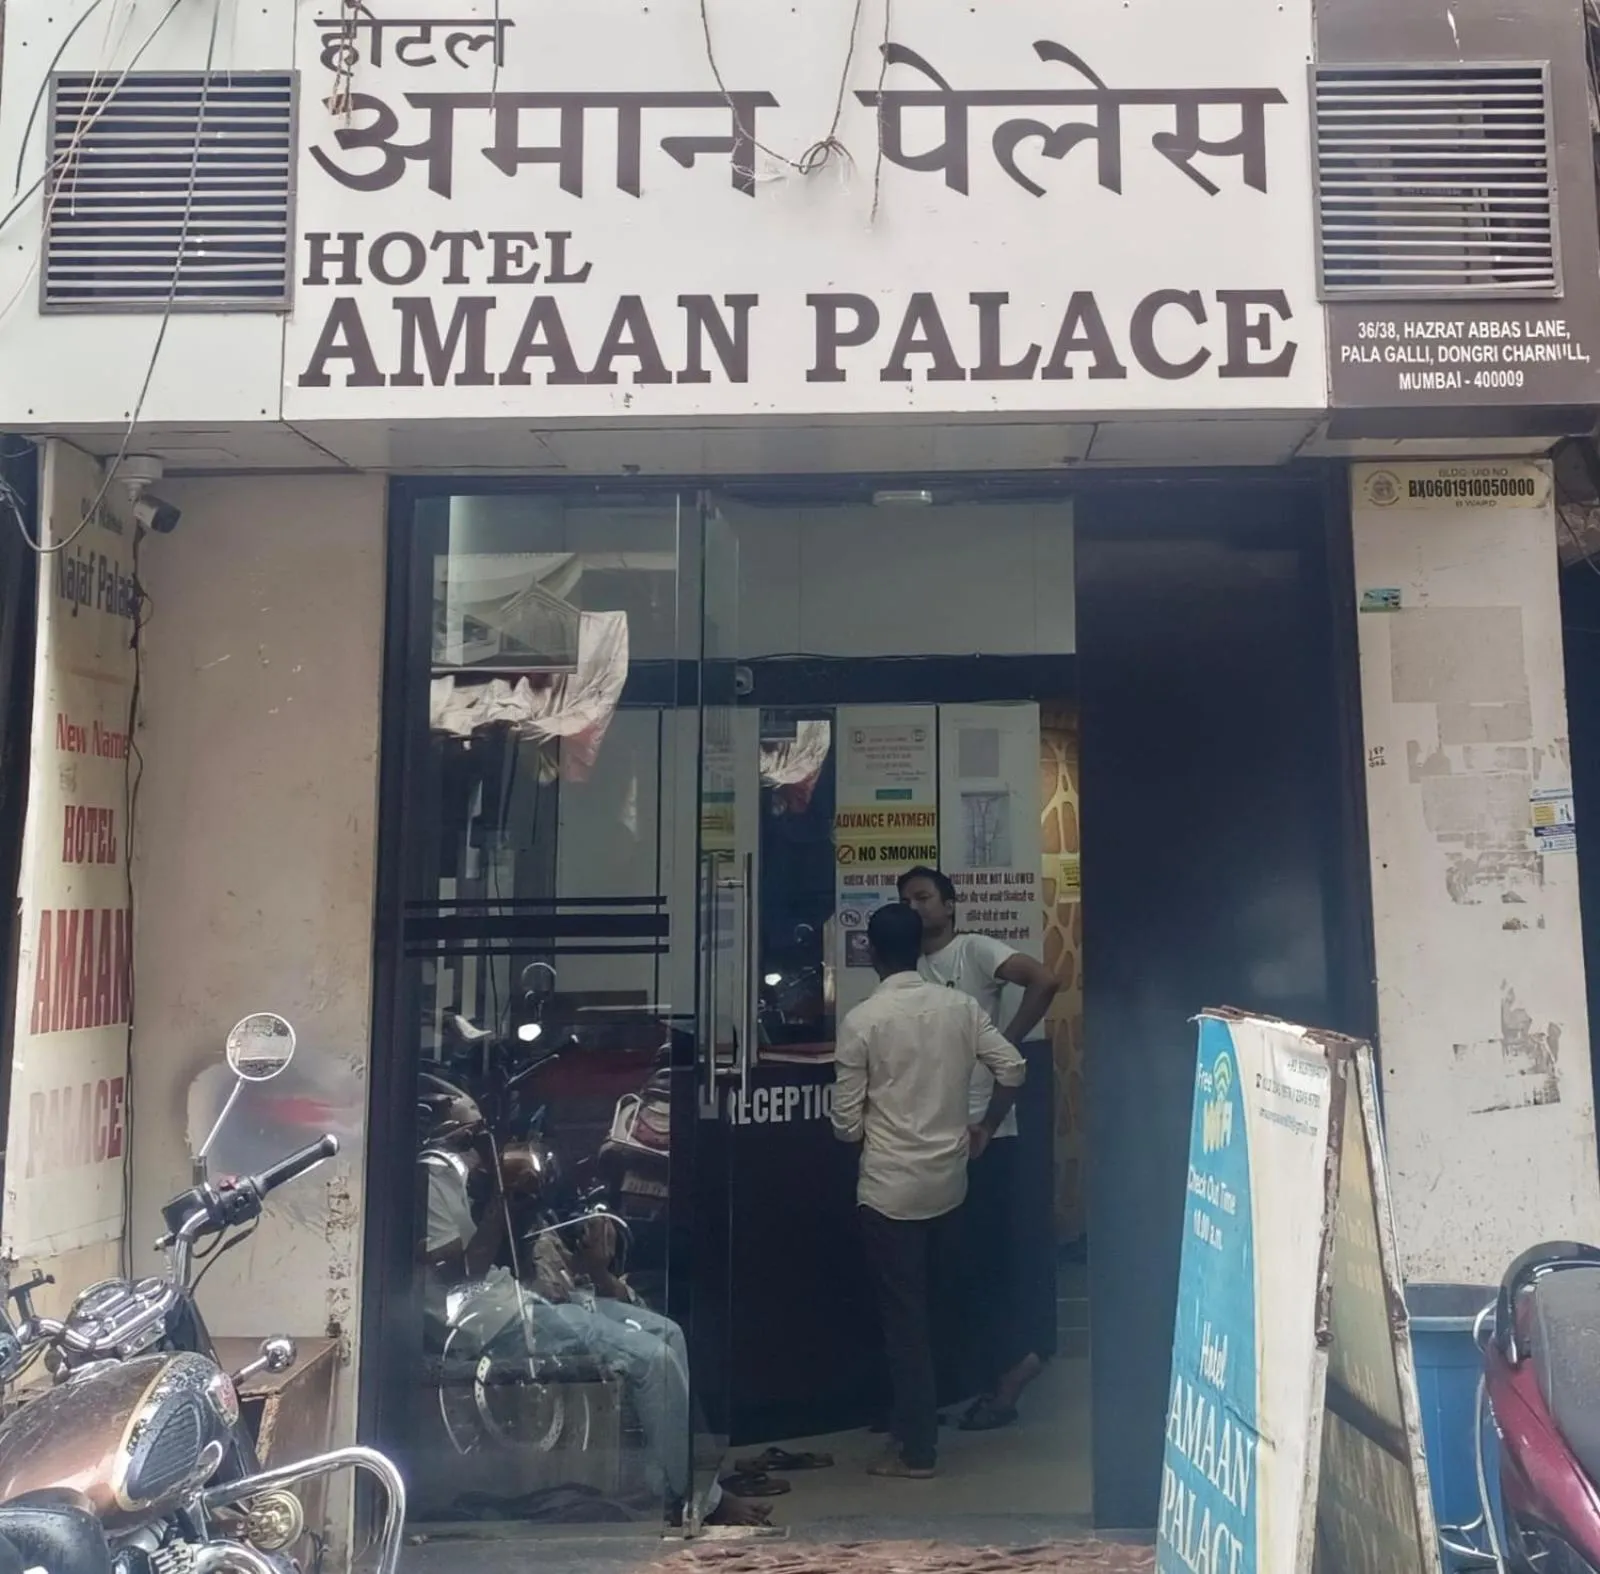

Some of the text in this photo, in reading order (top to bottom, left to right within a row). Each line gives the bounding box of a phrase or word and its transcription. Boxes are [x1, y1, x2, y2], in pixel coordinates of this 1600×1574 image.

[308, 40, 1288, 200] अमान पेलेस
[302, 229, 592, 286] HOTEL
[298, 289, 1298, 388] AMAAN PALACE
[1341, 345, 1381, 363] PALA
[1384, 345, 1434, 366] GALLI,
[1438, 344, 1499, 363] DONGRI
[1358, 319, 1571, 341] 36/38, HAZRAT ABBAS LANE,
[1399, 371, 1461, 390] MUMBAI
[1474, 370, 1524, 388] 400009
[56, 538, 95, 618] Najaf
[56, 713, 129, 761] New Name
[62, 805, 117, 864] HOTEL
[836, 812, 936, 829] ADVANCE PAYMENT
[858, 845, 937, 862] NO SMOKING
[30, 909, 132, 1036] AMAAN
[25, 1077, 124, 1179] PALACE
[728, 1084, 835, 1125] ECEPTIO
[1200, 1320, 1228, 1391] Hotel
[1166, 1374, 1254, 1518] AMAAN
